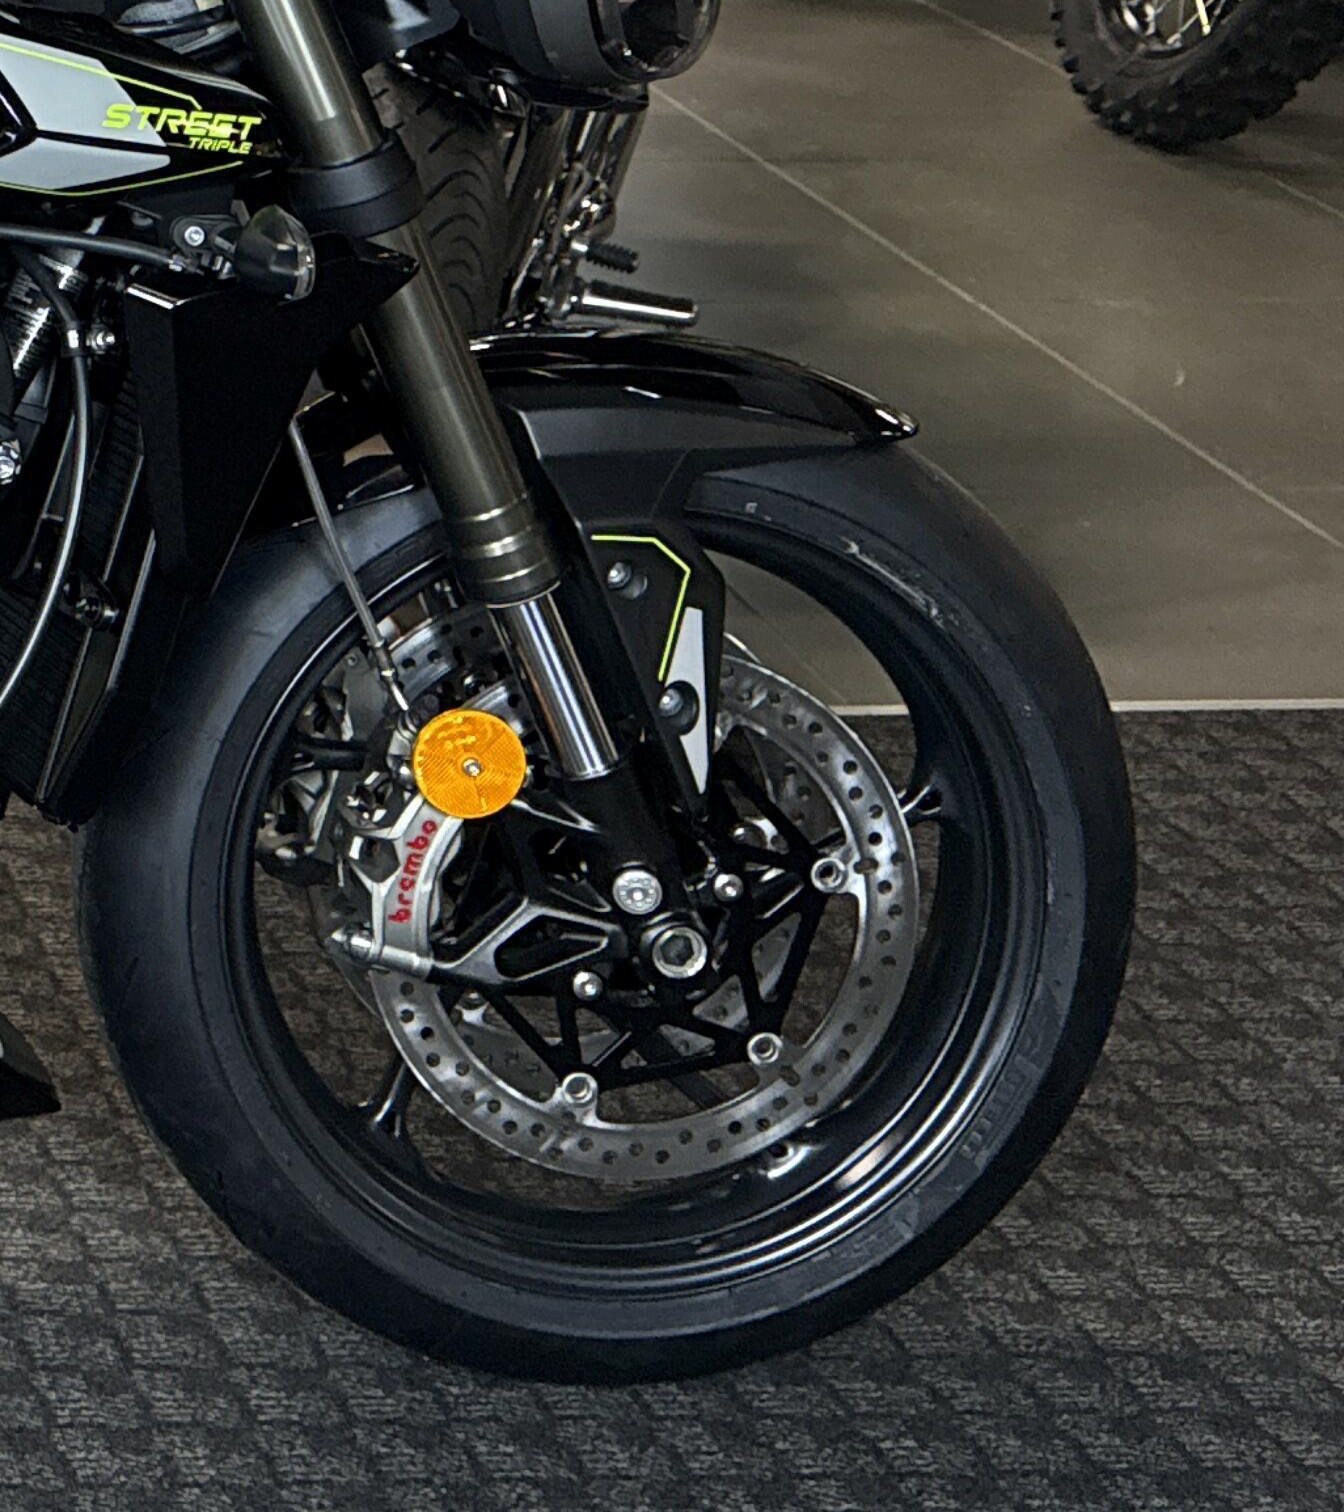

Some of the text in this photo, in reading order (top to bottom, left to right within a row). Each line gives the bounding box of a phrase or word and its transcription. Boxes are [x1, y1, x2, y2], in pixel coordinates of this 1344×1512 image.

[101, 102, 262, 140] STREET
[187, 136, 253, 155] TRIPLE
[387, 819, 438, 924] brembo
